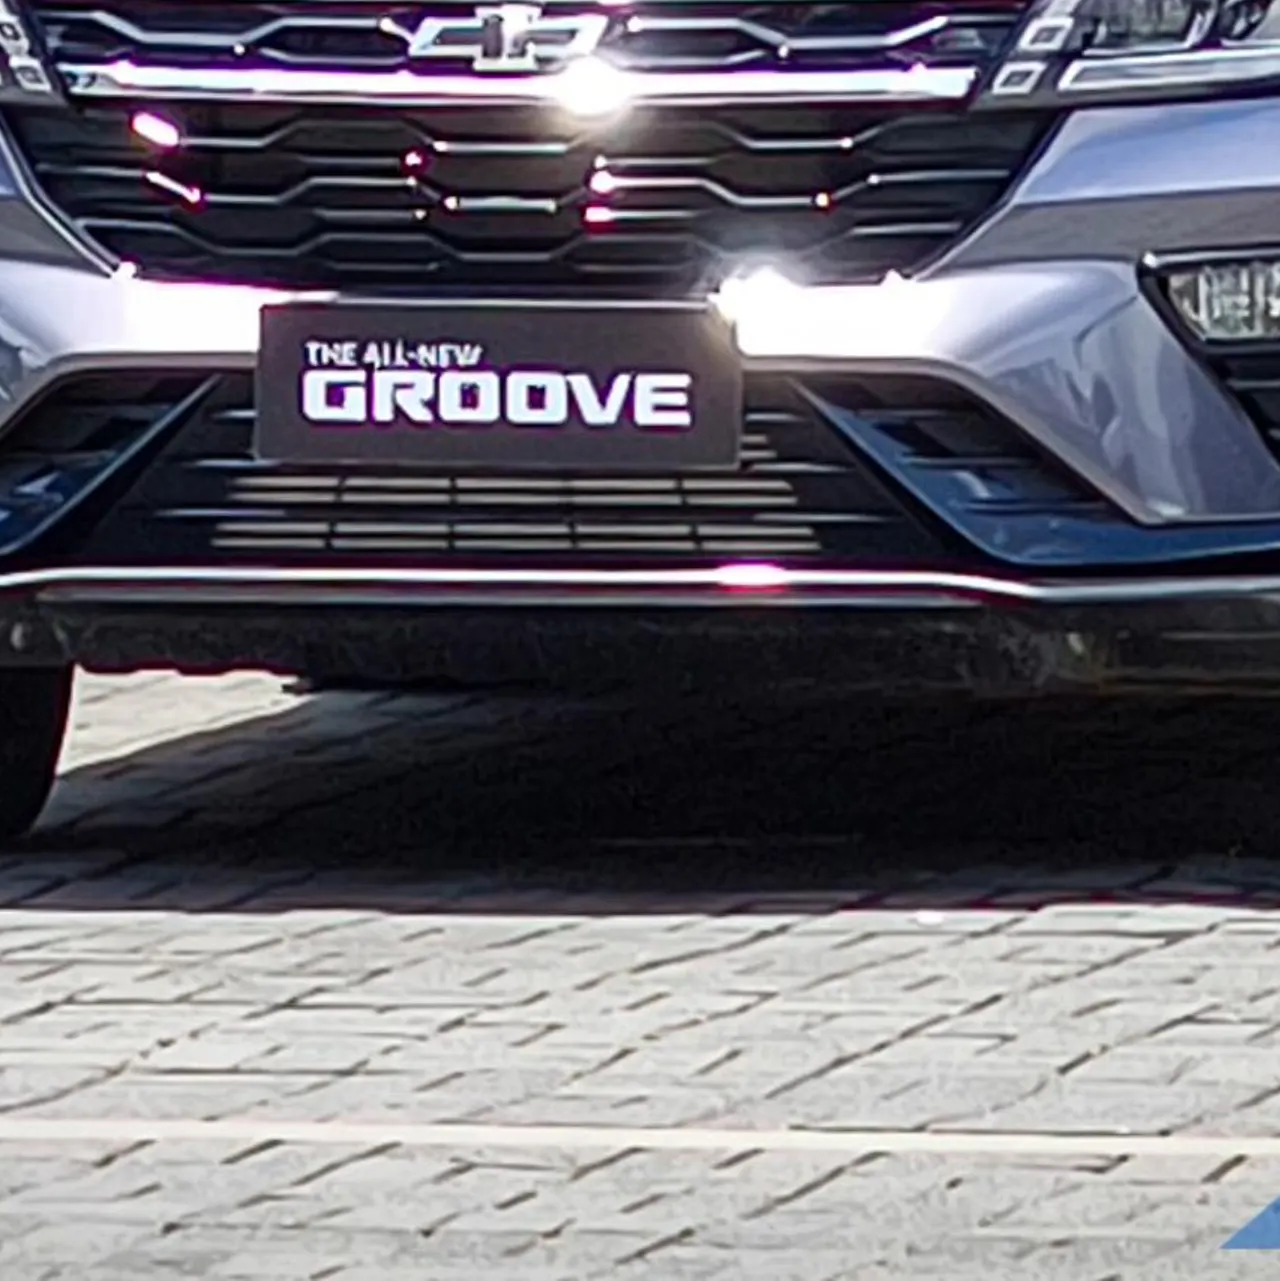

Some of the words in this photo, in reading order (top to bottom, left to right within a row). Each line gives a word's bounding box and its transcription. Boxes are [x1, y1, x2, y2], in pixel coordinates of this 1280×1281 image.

[304, 340, 358, 368] THE
[362, 337, 484, 370] ALL-NEW
[302, 370, 692, 426] GROOVE
